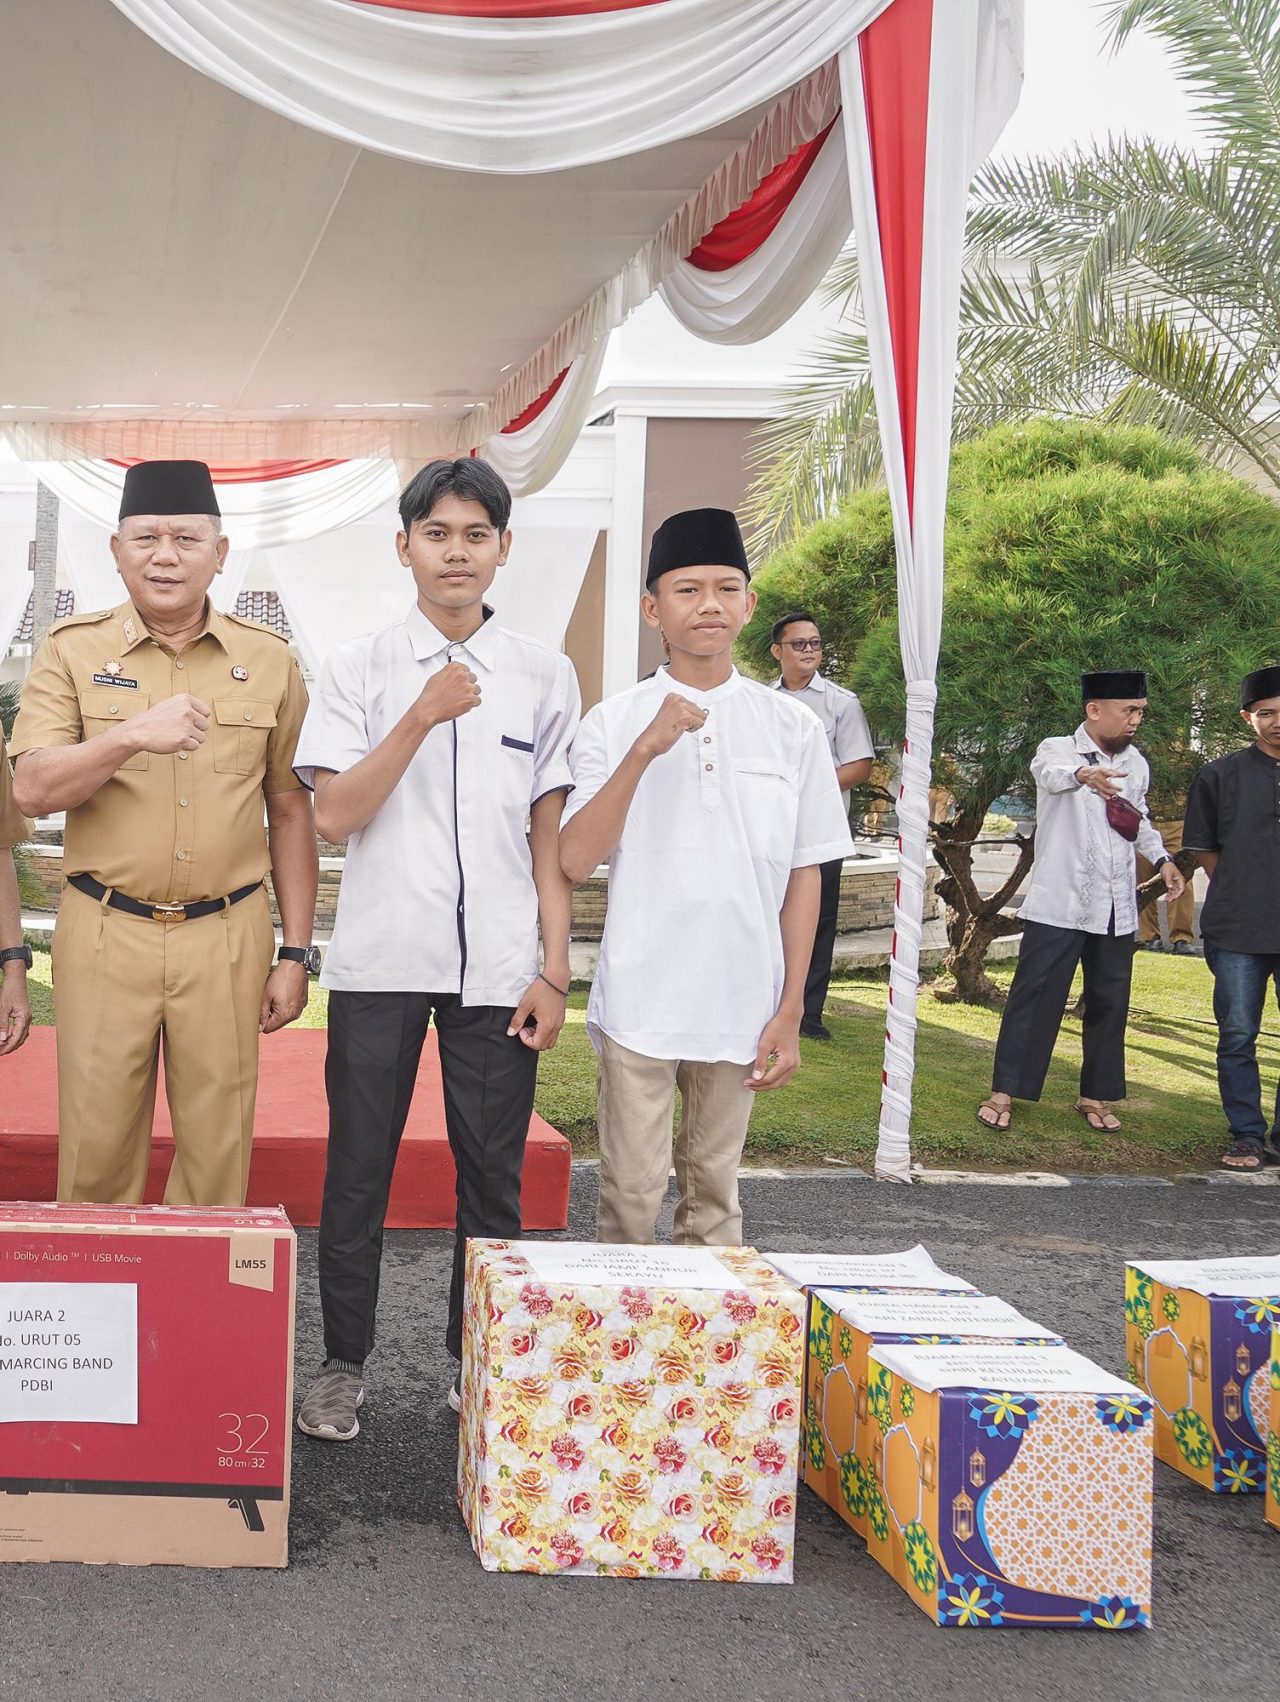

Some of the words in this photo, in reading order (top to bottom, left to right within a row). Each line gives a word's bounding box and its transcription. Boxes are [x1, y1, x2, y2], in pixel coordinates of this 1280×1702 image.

[95, 675, 113, 683] MUSNI
[114, 679, 136, 688] WIJAYA
[14, 1251, 40, 1263] Dolby
[42, 1252, 69, 1262] Audio
[93, 1253, 112, 1263] USB
[115, 1254, 143, 1264] Movie
[235, 1259, 267, 1269] LM55
[607, 1271, 664, 1279] SEKAYU
[7, 1310, 54, 1323] JUARA
[57, 1310, 66, 1322] 2
[20, 1333, 61, 1346] URUT
[64, 1333, 82, 1346] 05
[0, 1357, 68, 1371] MARCING
[72, 1357, 114, 1370] BAND
[977, 1367, 1072, 1376] KELURAHAN
[20, 1379, 54, 1392] PDBI
[978, 1375, 1055, 1384] KAYUARA
[216, 1413, 270, 1455] 32
[218, 1456, 234, 1467] 80
[234, 1460, 247, 1468] cm
[251, 1457, 266, 1468] 32
